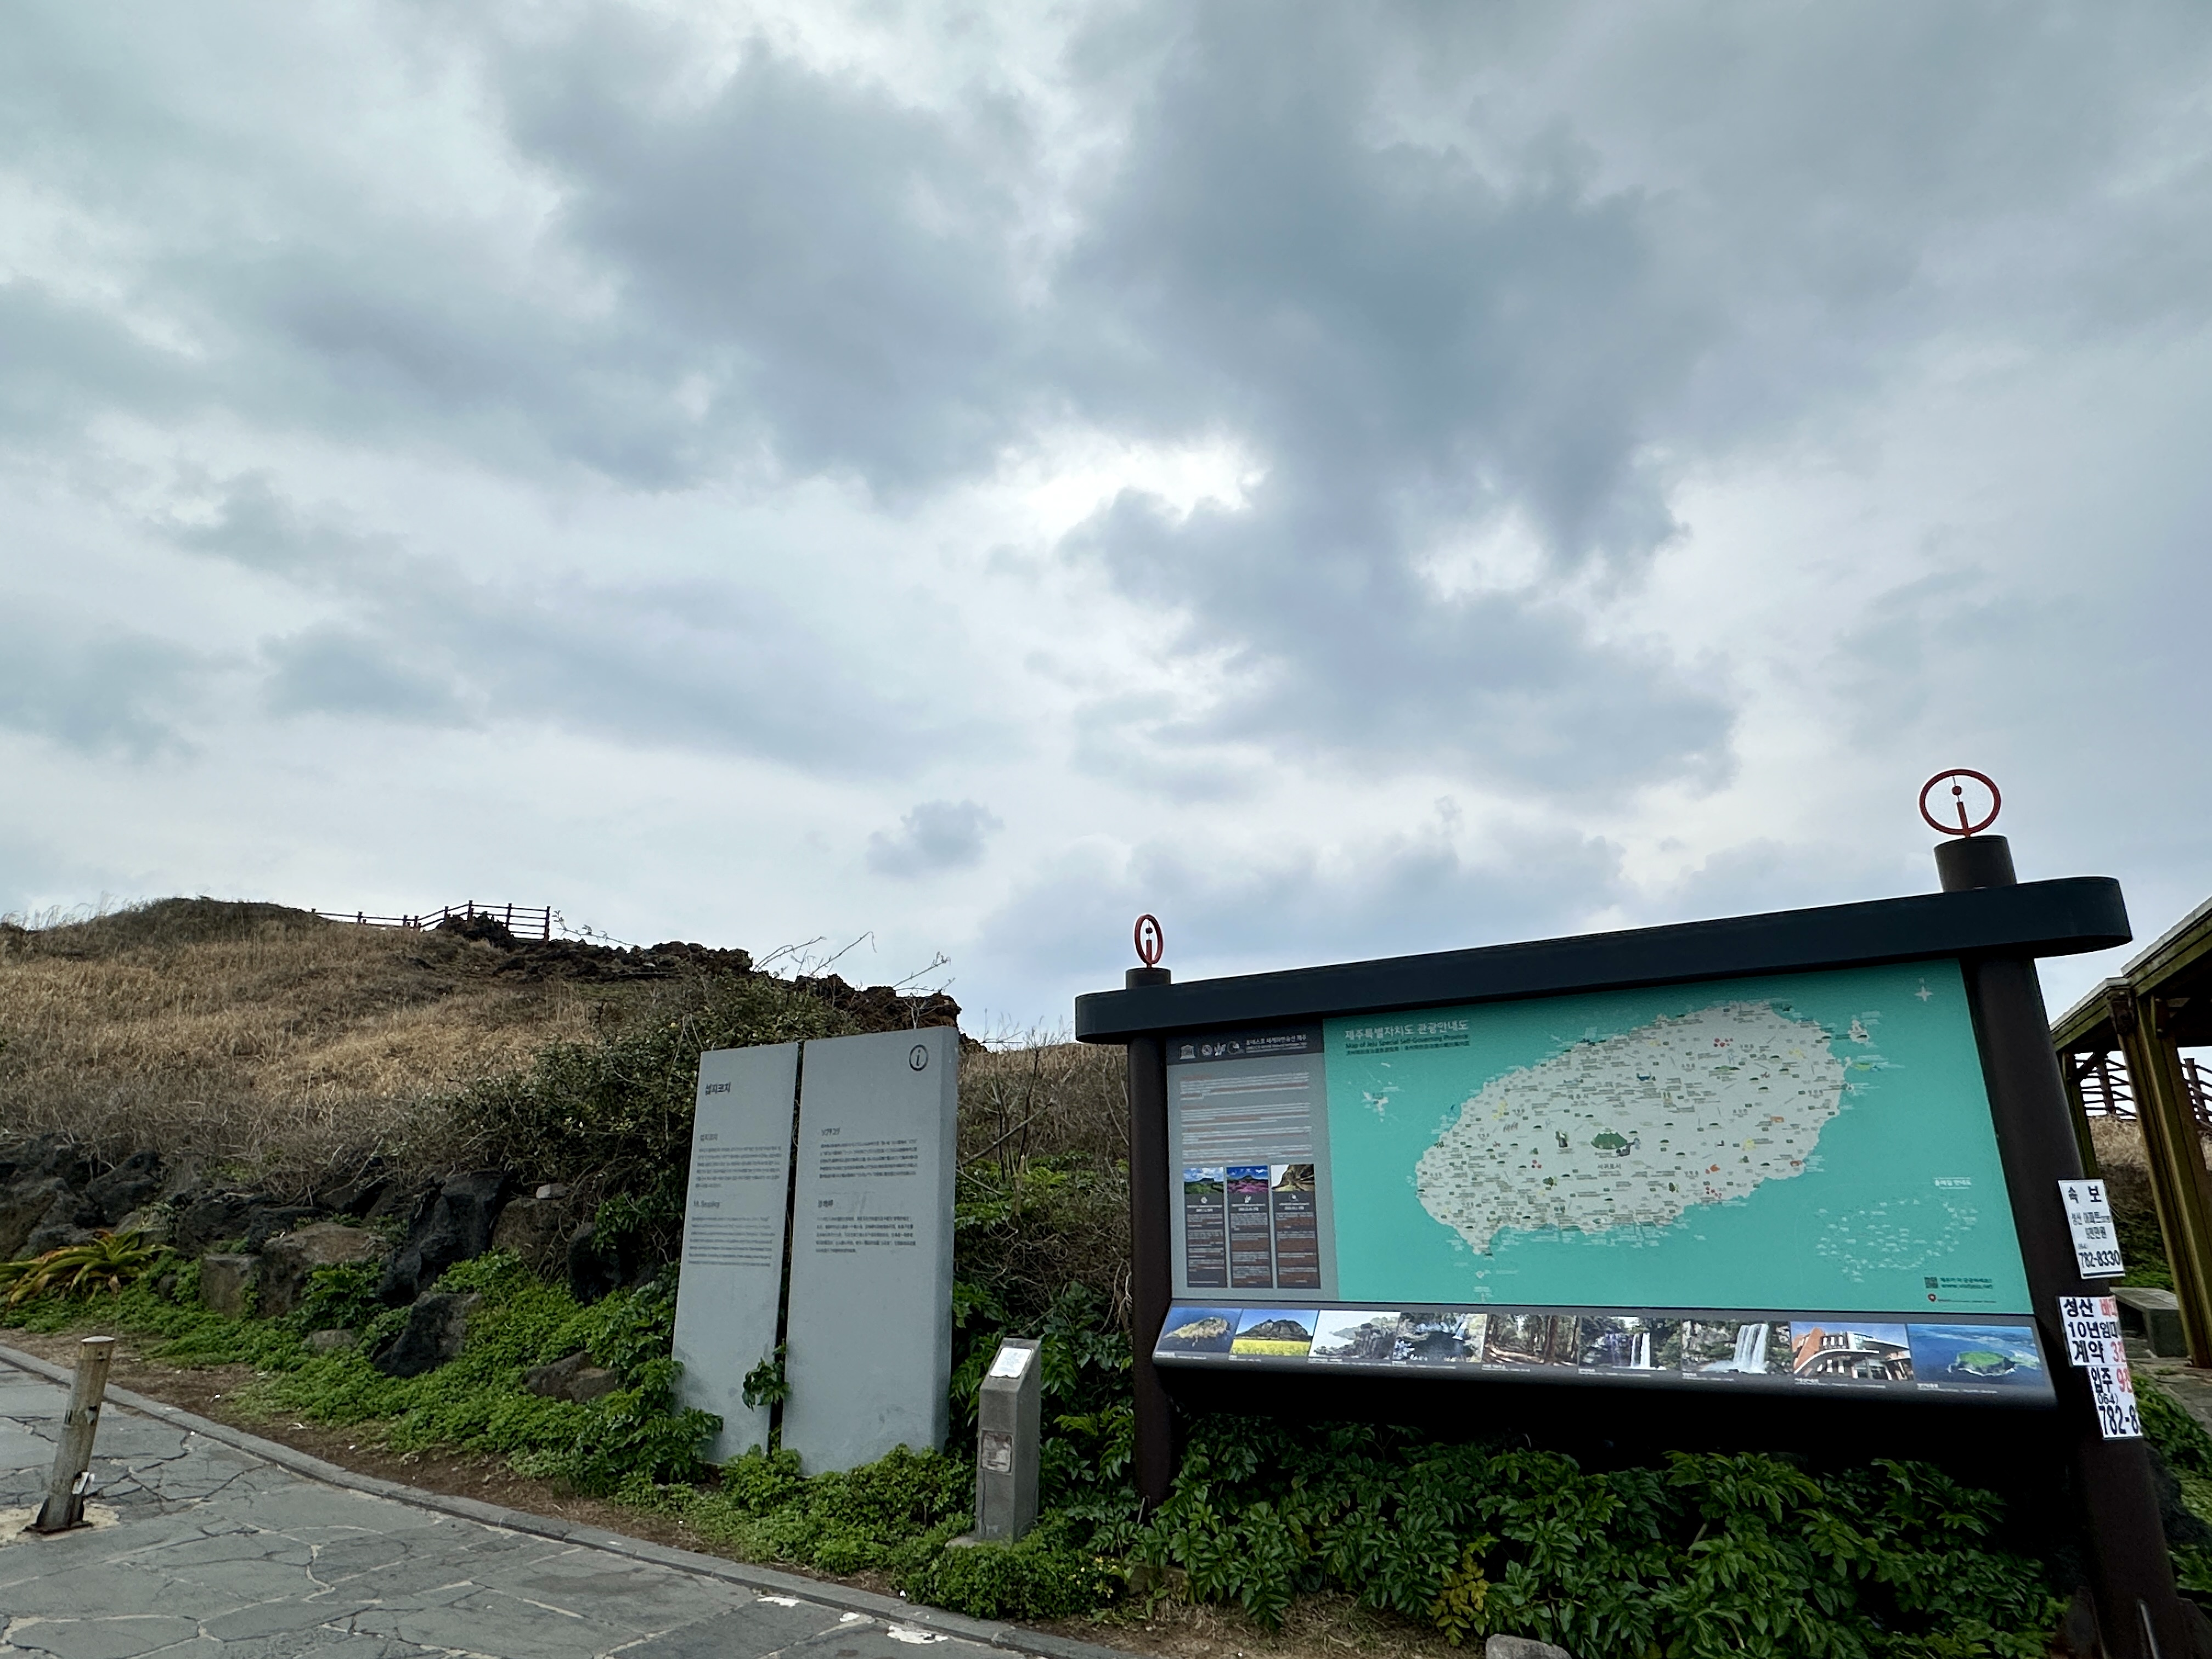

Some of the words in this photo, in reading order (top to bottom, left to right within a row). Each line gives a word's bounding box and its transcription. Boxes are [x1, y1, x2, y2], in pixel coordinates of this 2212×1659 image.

[1345, 1024, 1414, 1040] 제주특별자치도
[1417, 1020, 1469, 1035] 관광안내도
[705, 1082, 731, 1096] 섭지코지
[2068, 1187, 2079, 1204] 속
[2087, 1186, 2102, 1203] 보
[2078, 1250, 2121, 1268] 782-8330
[2063, 1298, 2094, 1317] 성산
[2072, 1340, 2104, 1363] 계약
[2091, 1367, 2113, 1393] 입주
